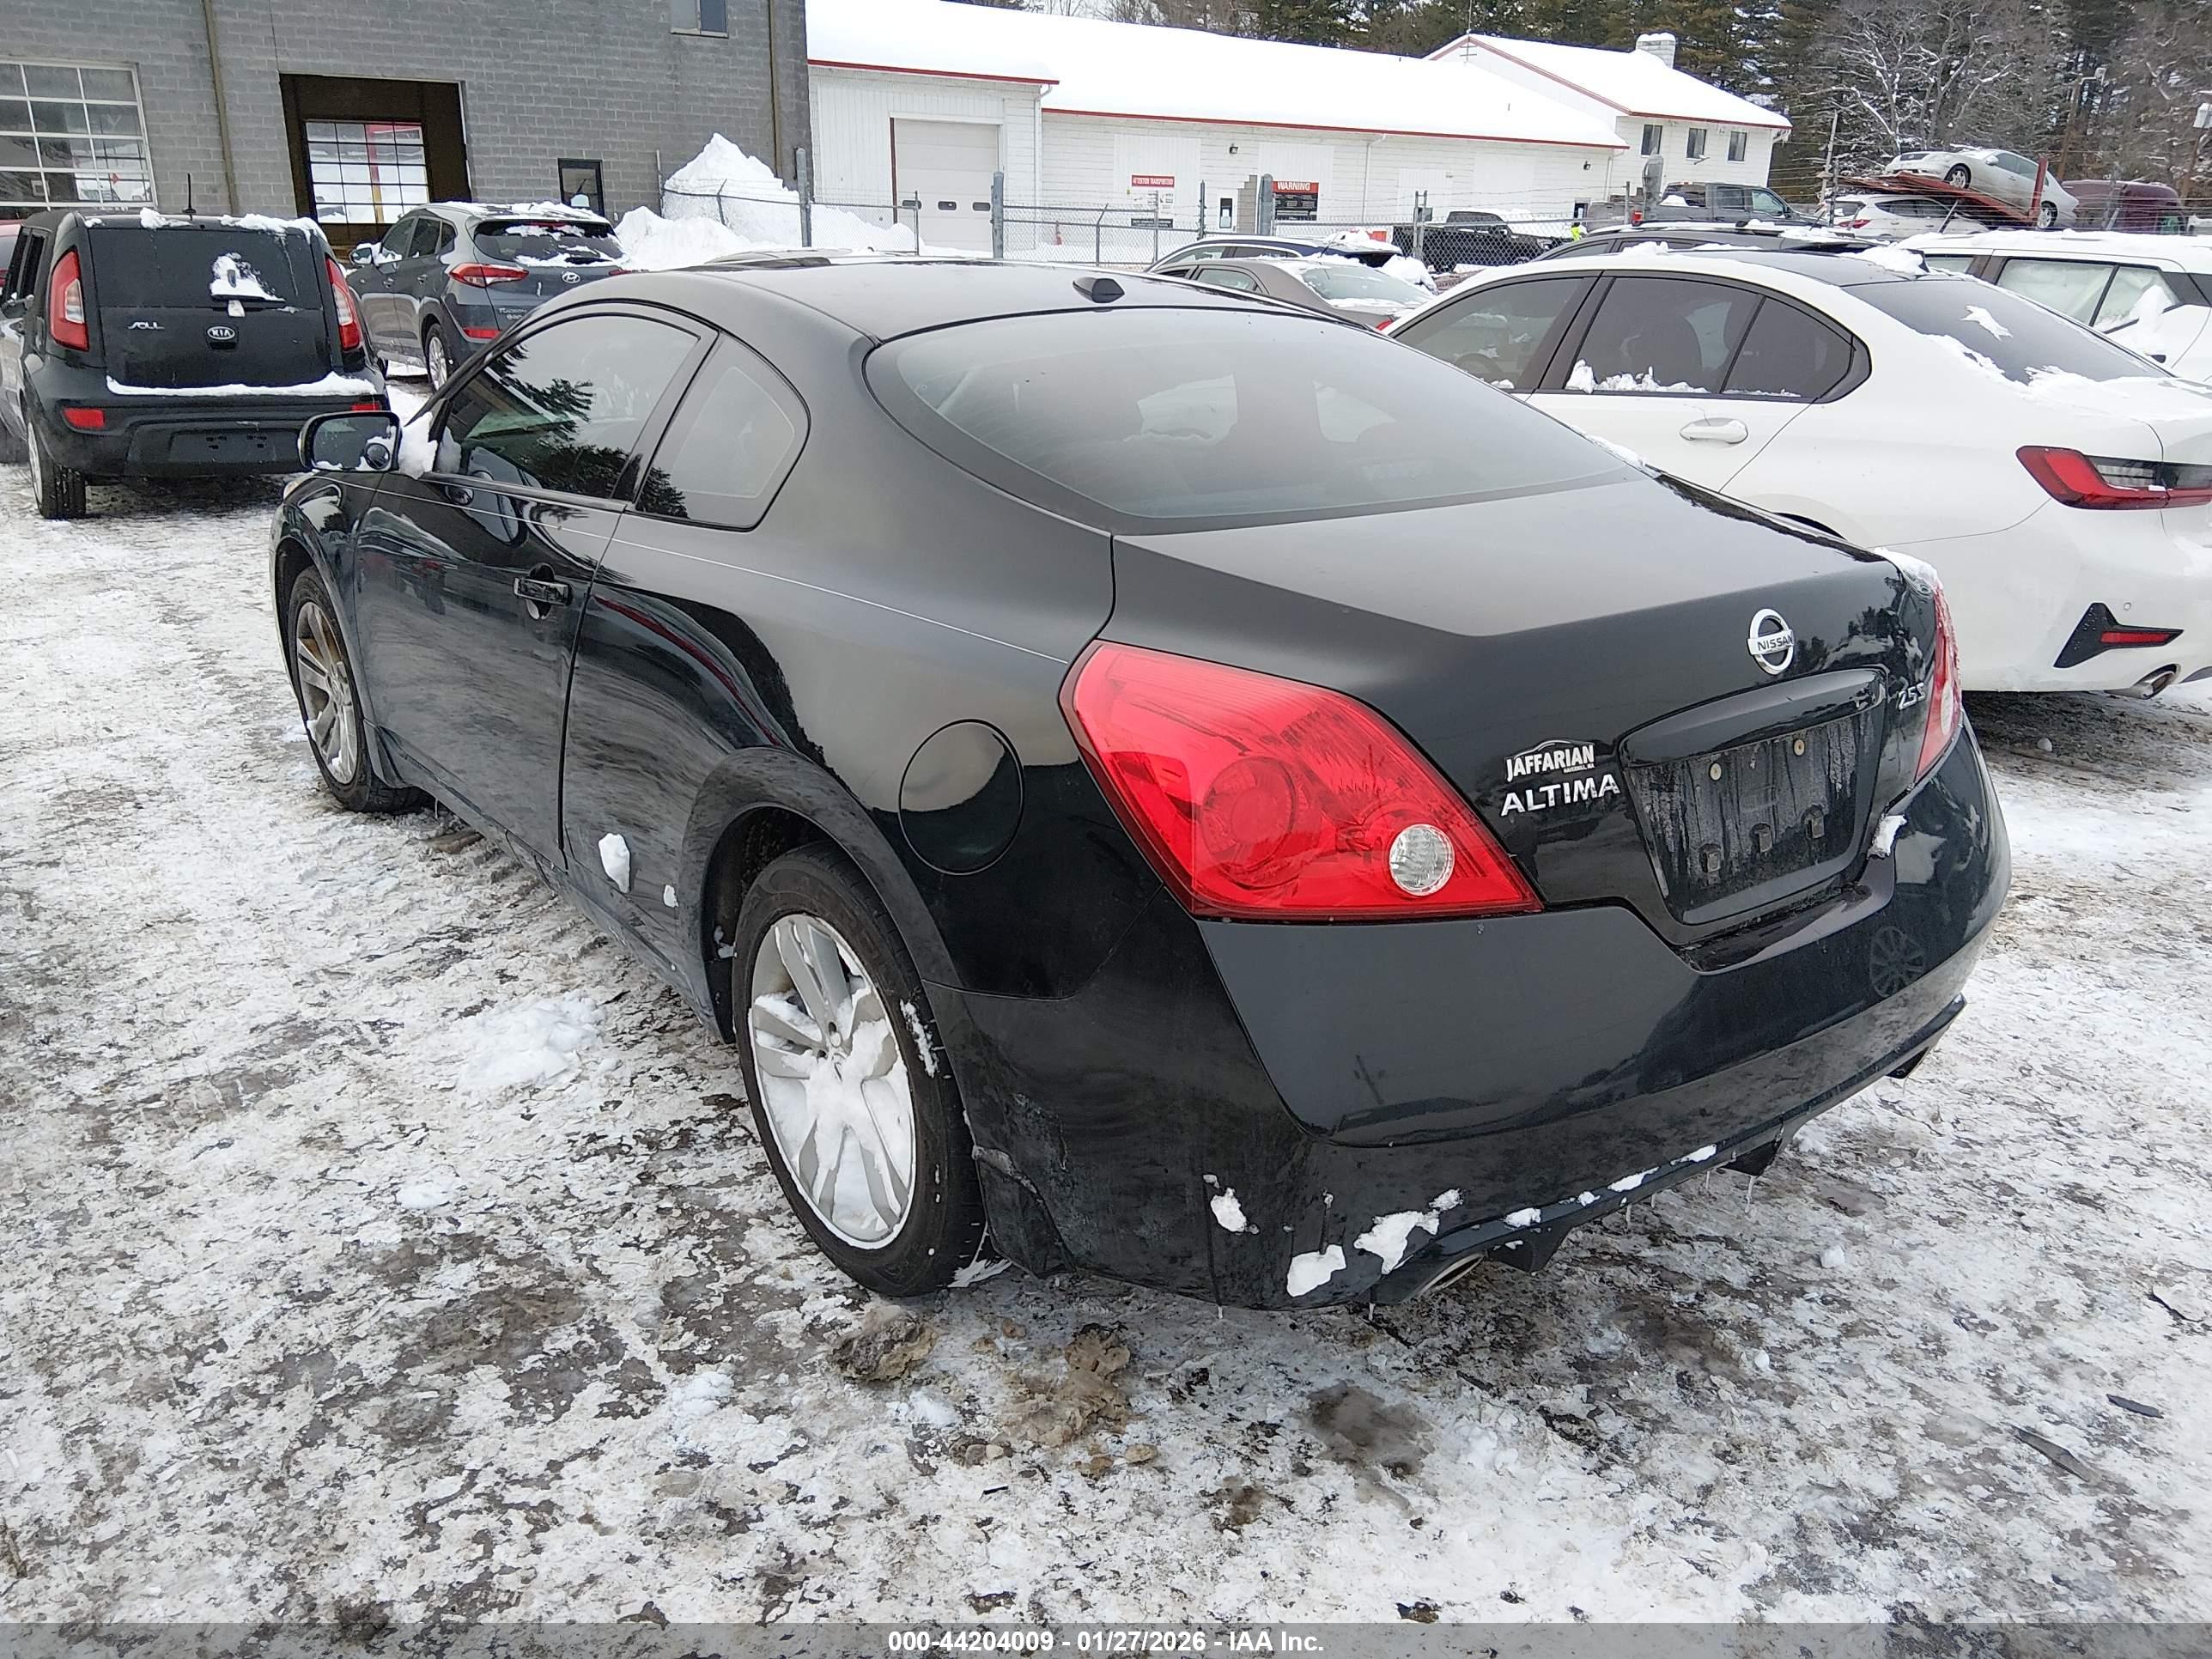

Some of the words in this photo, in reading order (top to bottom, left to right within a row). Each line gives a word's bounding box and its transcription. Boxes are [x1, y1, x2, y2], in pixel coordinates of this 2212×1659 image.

[1277, 181, 1311, 191] WARNING
[1757, 634, 1794, 651] NISSAN
[1506, 744, 1595, 782] JAFFARIAN
[1500, 774, 1621, 817] ALTIMA
